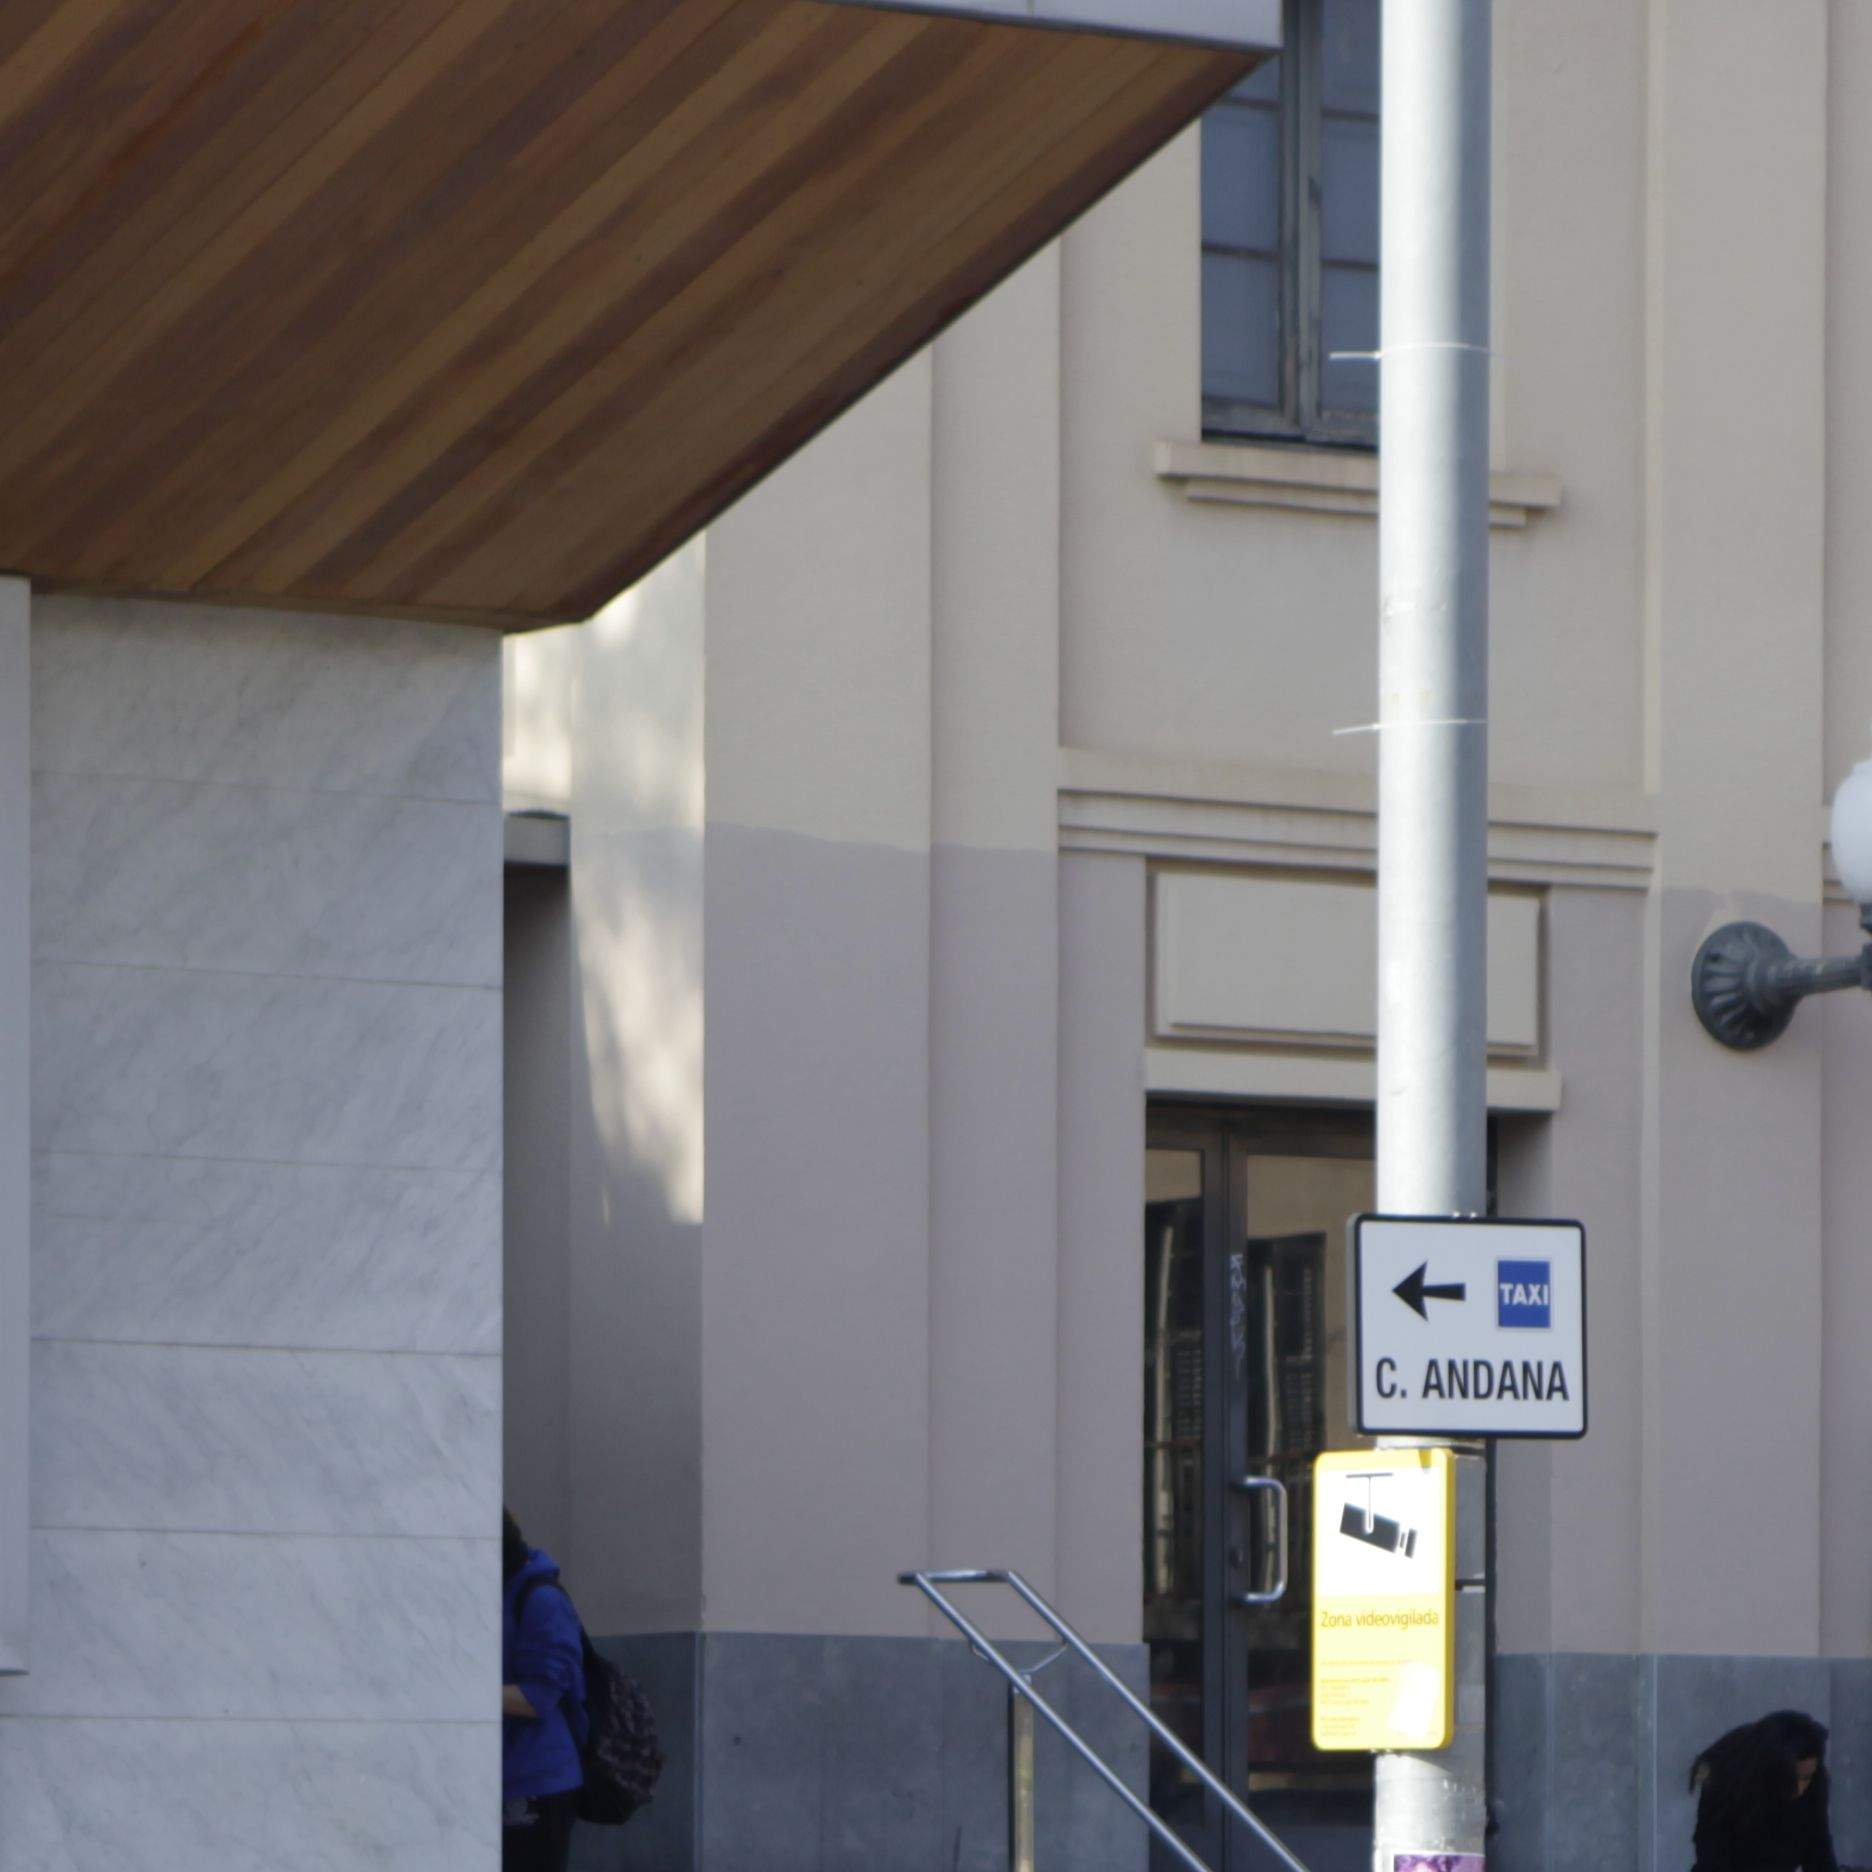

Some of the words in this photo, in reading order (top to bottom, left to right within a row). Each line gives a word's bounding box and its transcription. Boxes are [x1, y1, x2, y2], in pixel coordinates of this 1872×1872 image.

[1499, 1282, 1550, 1306] TAXI
[1375, 1356, 1408, 1400] C.
[1421, 1358, 1570, 1401] ANDANA
[1320, 1610, 1353, 1628] Zona
[1355, 1608, 1440, 1631] videovigilada
